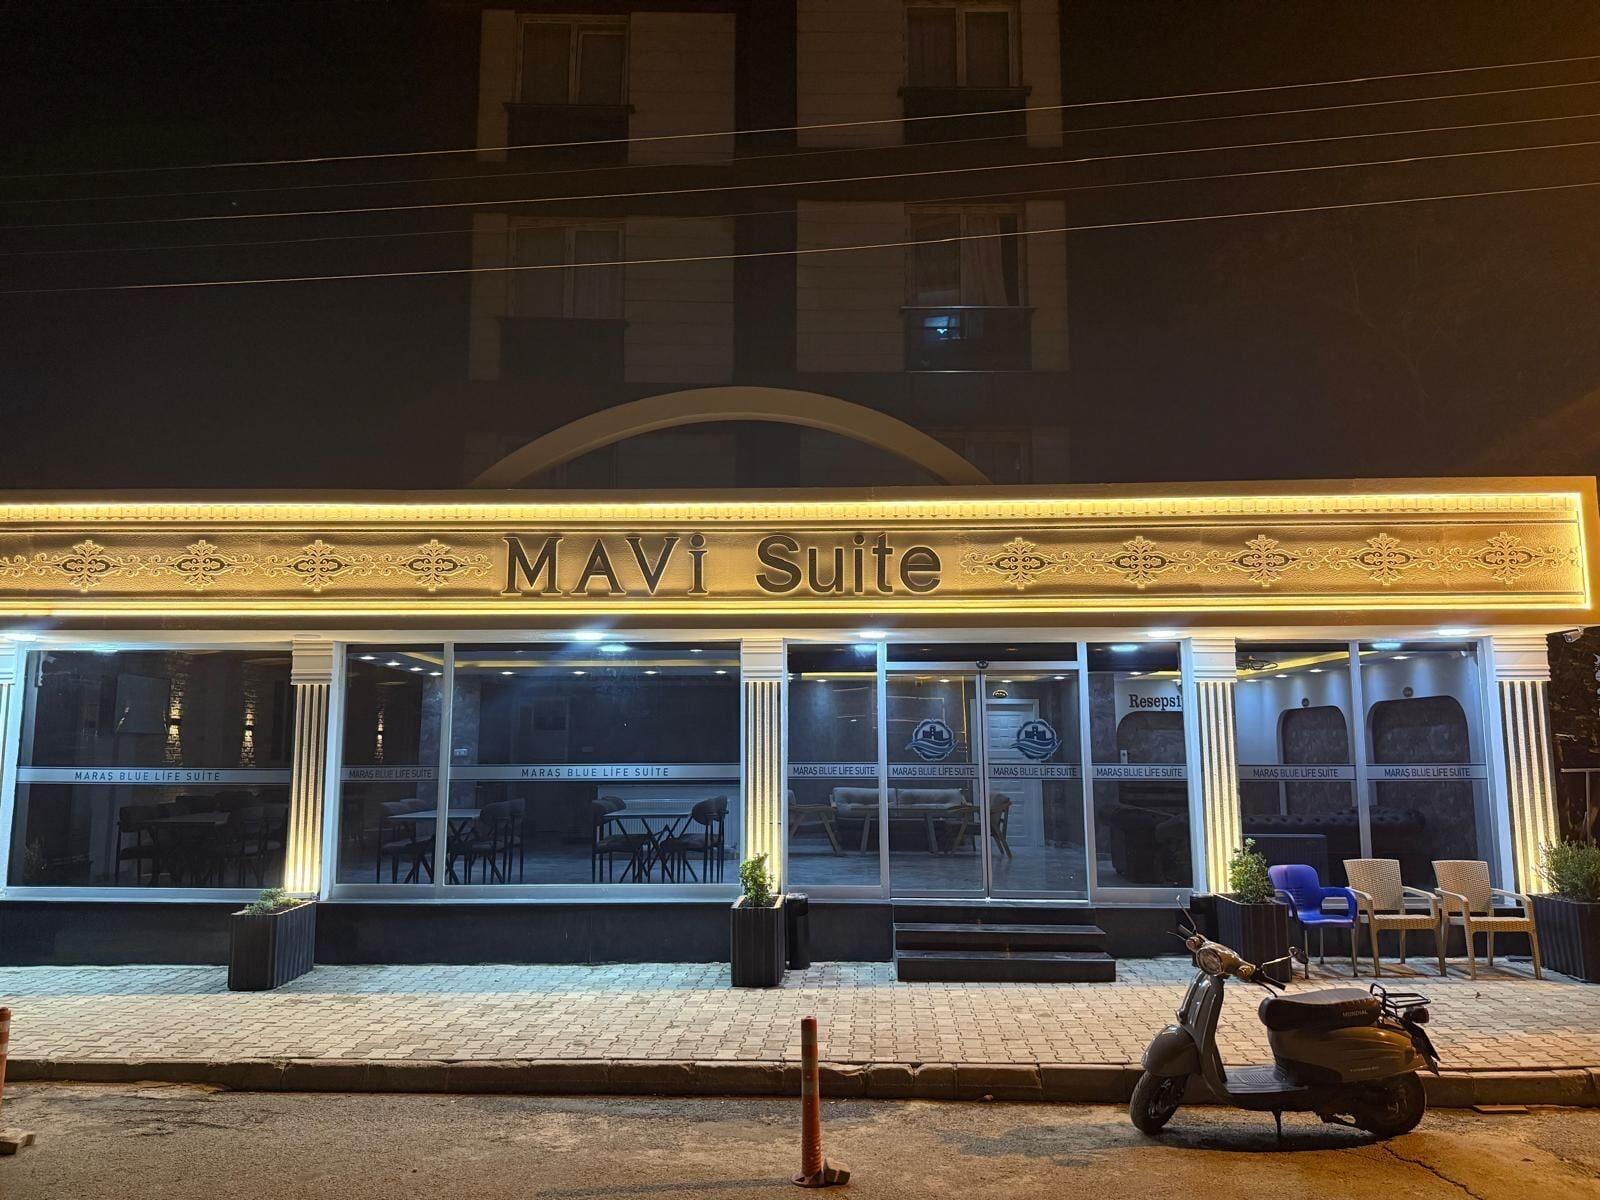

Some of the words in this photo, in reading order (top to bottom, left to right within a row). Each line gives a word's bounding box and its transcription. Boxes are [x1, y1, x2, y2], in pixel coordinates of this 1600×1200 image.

[756, 533, 941, 594] Suite
[1128, 694, 1183, 711] Resepsi
[74, 771, 114, 781] MARAŞ
[119, 771, 149, 781] BLUE
[155, 770, 180, 781] LİFE
[186, 771, 221, 781] SUİTE
[521, 768, 561, 779] MARAŞ
[567, 768, 597, 777] BLUE
[603, 766, 629, 777] LİFE
[635, 766, 670, 777] SUİTE
[819, 766, 837, 775] BLUE
[918, 767, 937, 776] BLUE
[1019, 767, 1039, 776] BLUE
[1040, 765, 1055, 776] LİFE
[1096, 768, 1122, 778] MARAŞ
[1124, 768, 1143, 777] BLUE
[1145, 766, 1161, 777] LİFE
[1280, 768, 1300, 778] BLUE
[1384, 768, 1410, 778] MARAŞ
[1412, 768, 1431, 777] BLUE
[1432, 767, 1448, 777] LİFE
